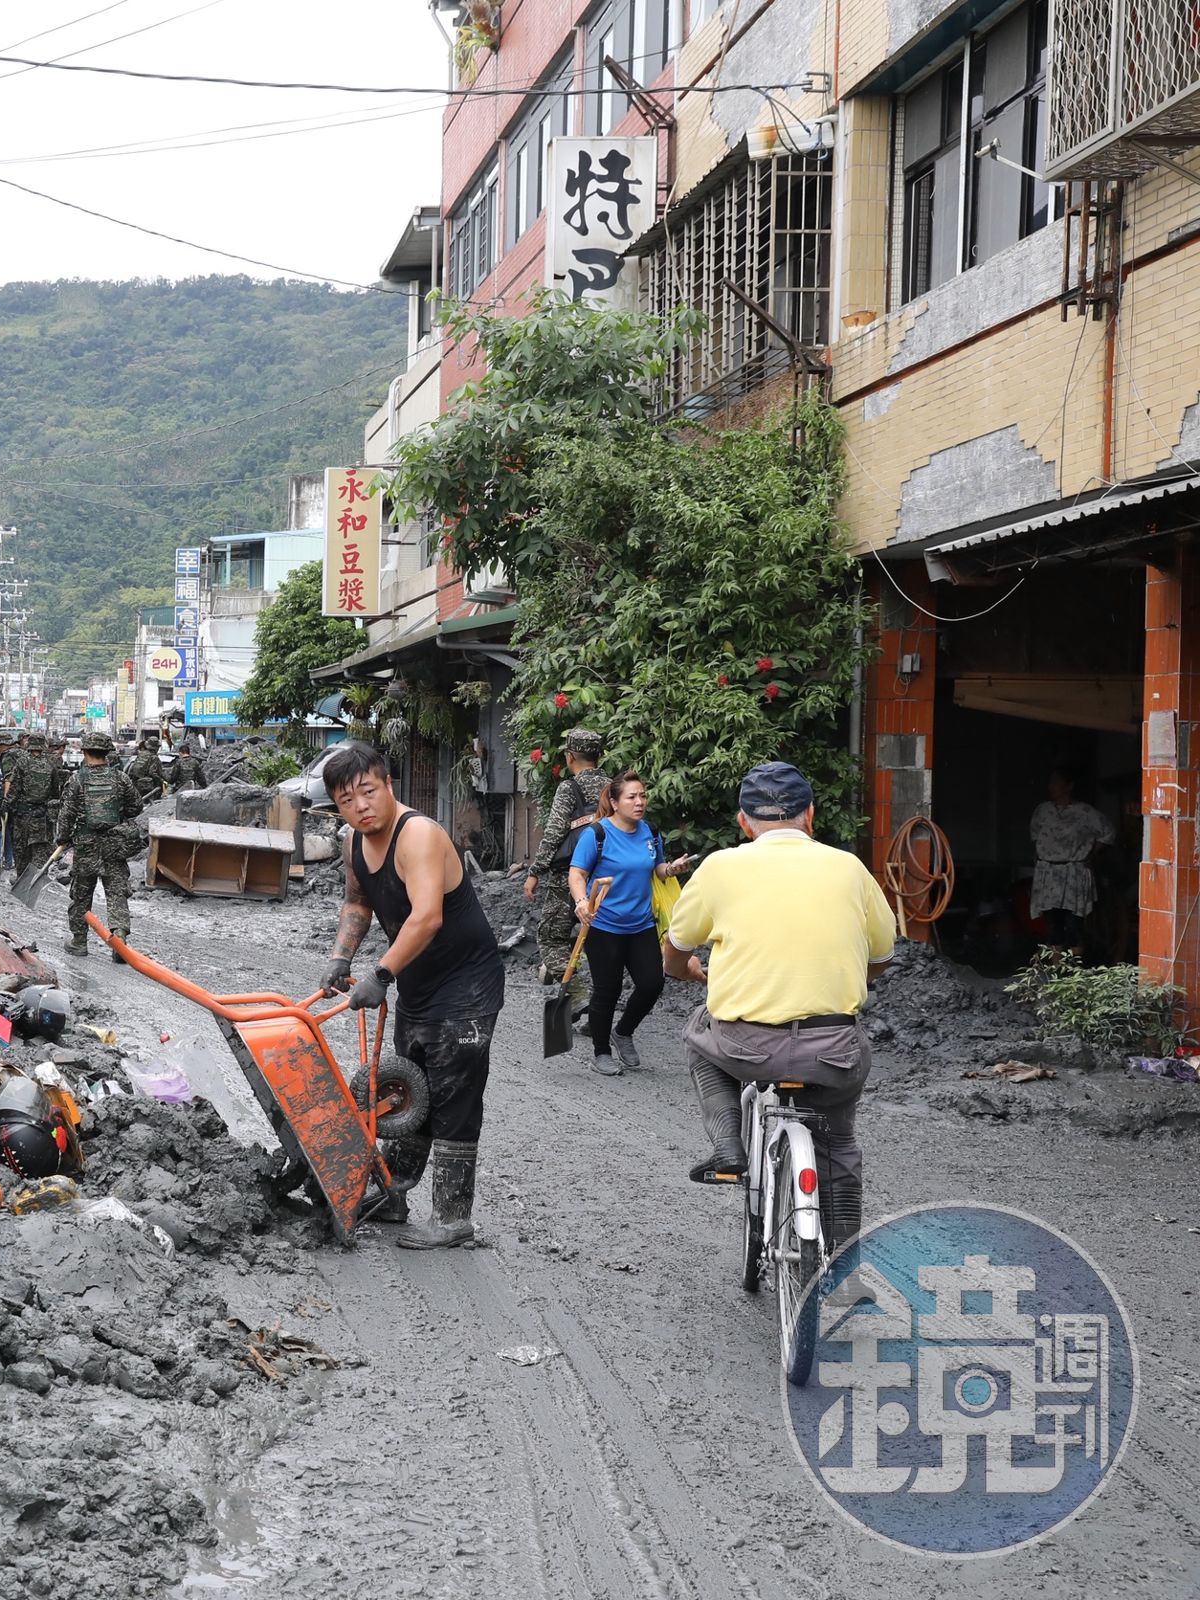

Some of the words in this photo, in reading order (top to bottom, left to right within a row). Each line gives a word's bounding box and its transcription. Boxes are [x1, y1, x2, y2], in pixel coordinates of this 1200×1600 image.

[337, 470, 368, 612] 永和豆漿
[152, 658, 178, 669] 24H
[191, 697, 237, 715] 康健加
